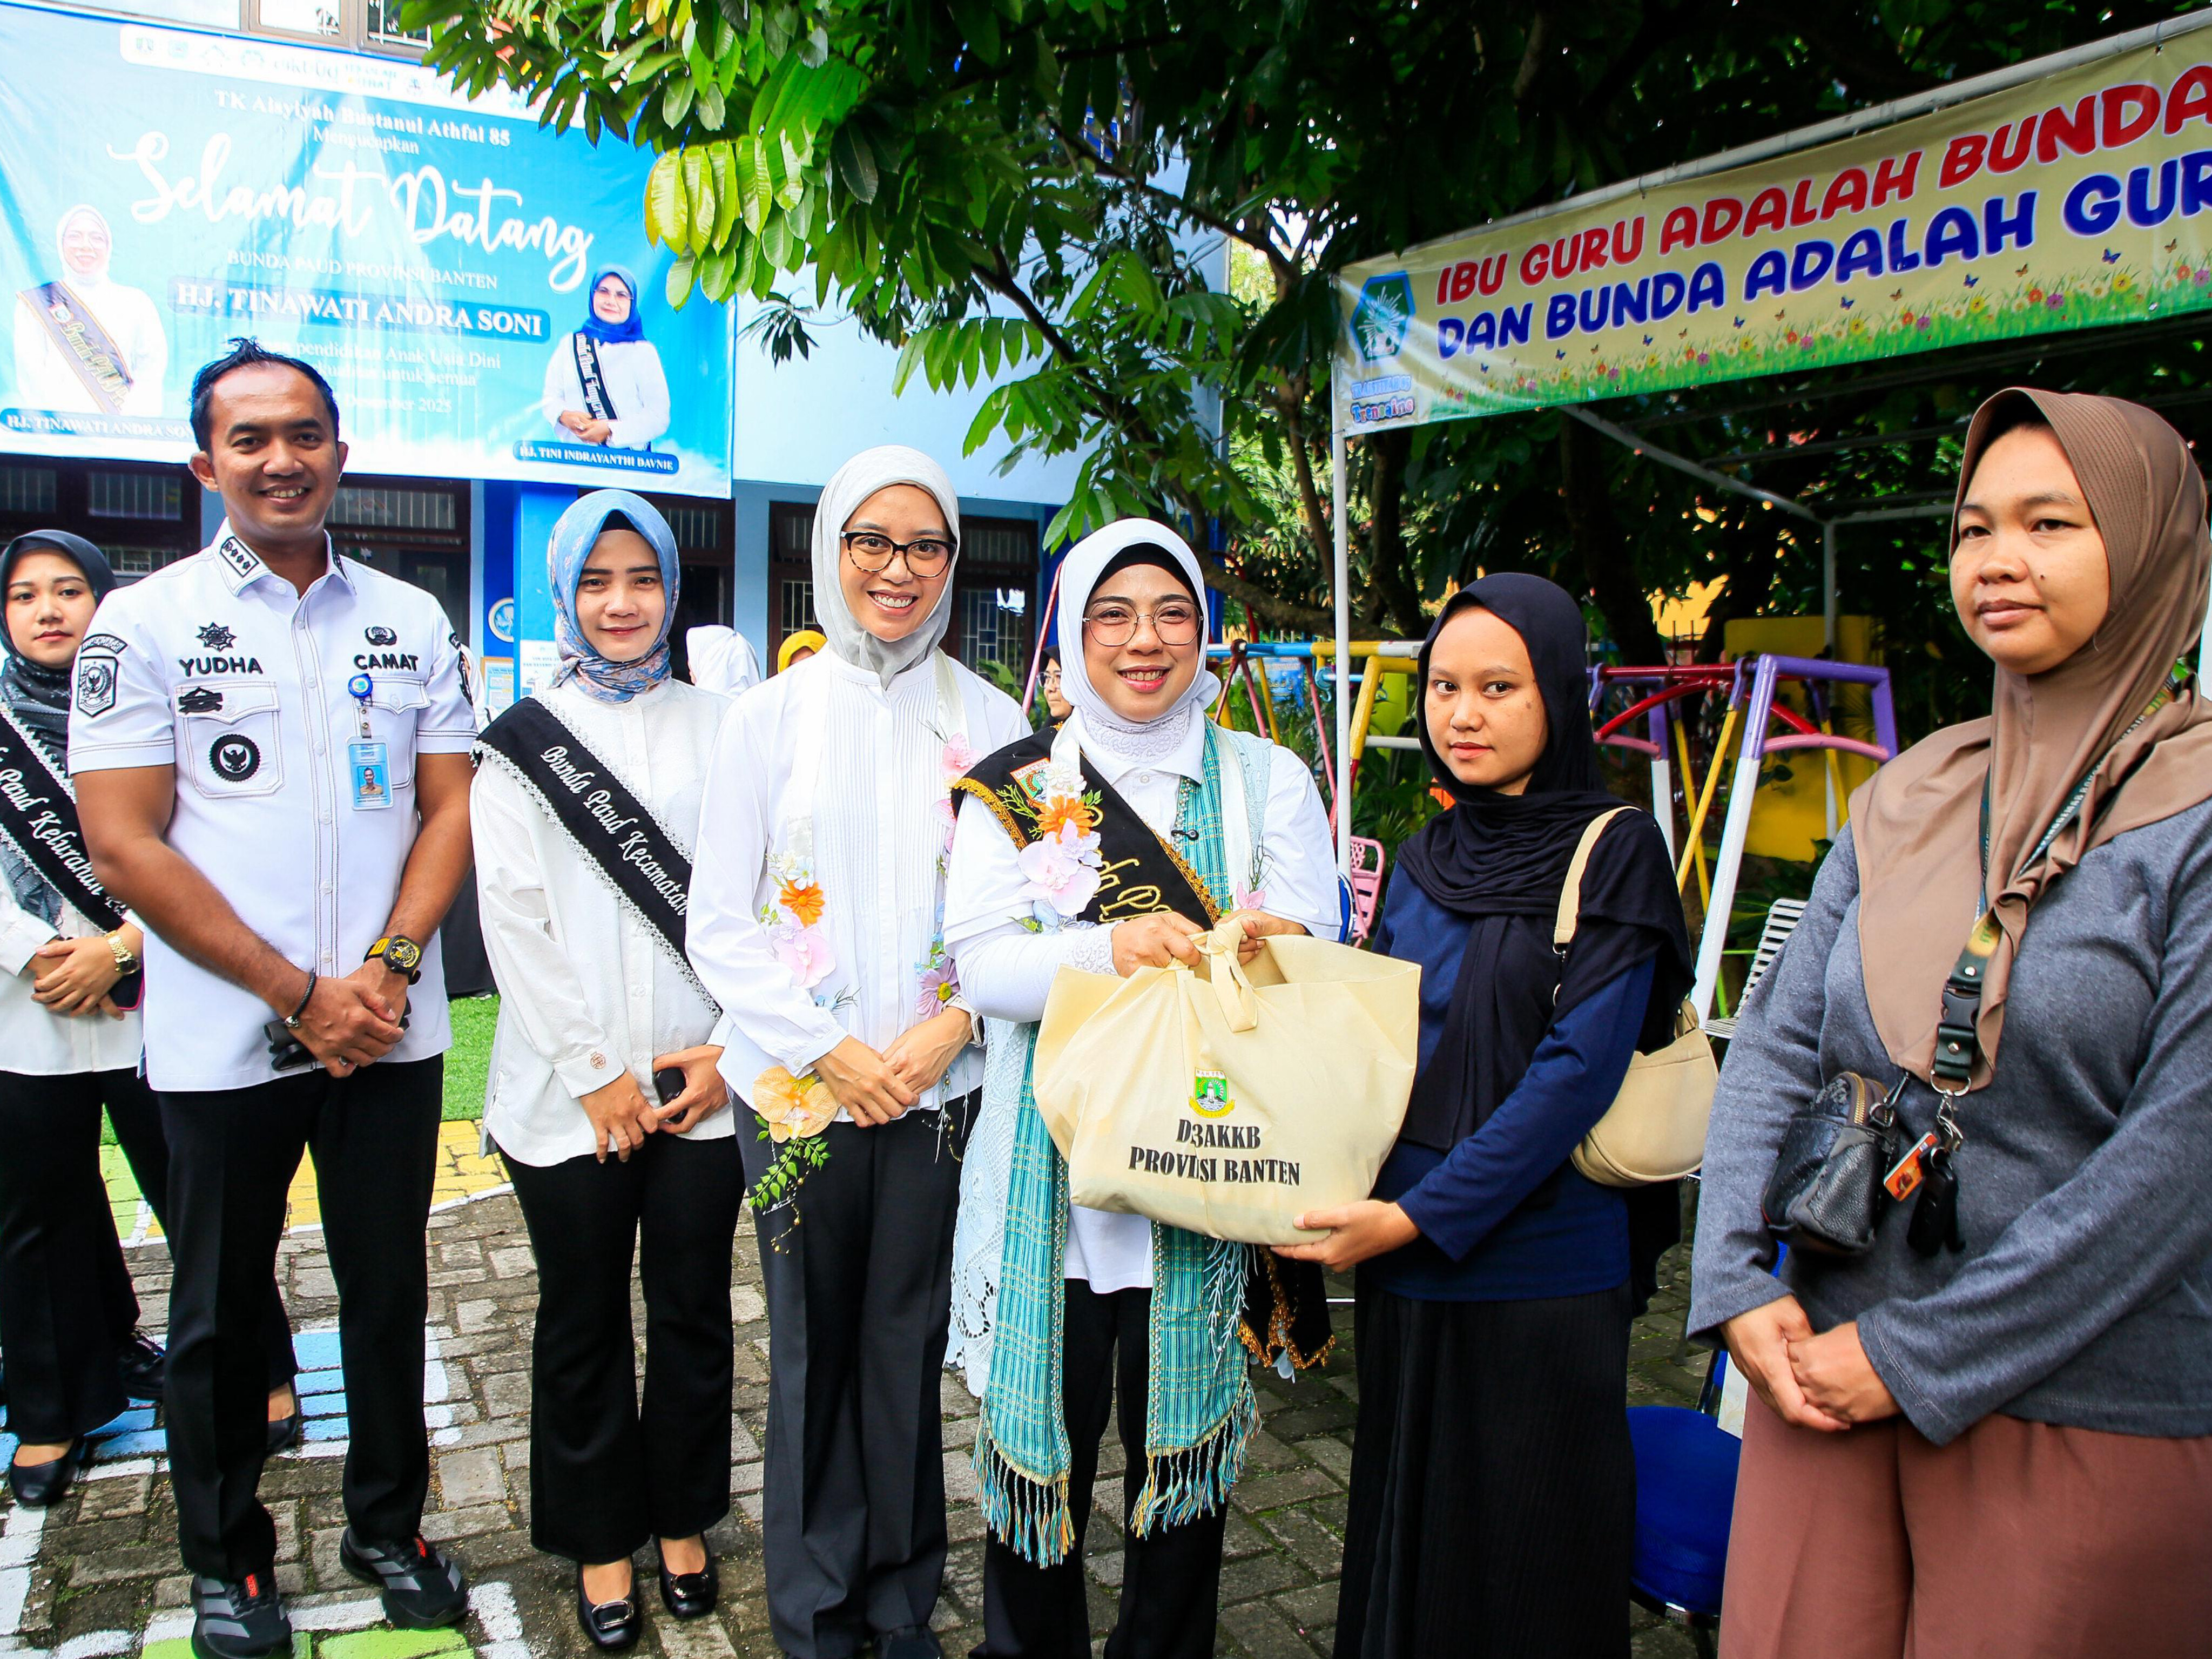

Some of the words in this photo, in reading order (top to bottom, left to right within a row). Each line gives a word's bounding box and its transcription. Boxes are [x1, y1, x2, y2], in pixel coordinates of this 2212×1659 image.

[214, 89, 246, 111] TK
[340, 107, 423, 135] Bustanul
[1437, 254, 1507, 304] IBU
[1520, 217, 1644, 286] GURU
[1660, 151, 1922, 255] ADALAH
[1940, 65, 2212, 189] BUNDA
[106, 131, 388, 238] Selamat
[389, 165, 594, 293] Datang
[227, 249, 292, 271] BUNDA
[431, 267, 498, 290] BANTEN
[1438, 302, 1532, 359] DAN
[1546, 262, 1724, 339] BUNDA
[1744, 191, 2037, 301] ADALAH
[177, 282, 222, 308] HJ.
[228, 287, 370, 322] TINAWATI
[374, 302, 474, 330] ANDRA
[477, 309, 543, 338] SONI
[386, 346, 426, 365] Anak
[469, 351, 502, 369] Dini
[6, 415, 31, 429] HJ.
[33, 417, 108, 433] TINAWATI
[112, 422, 163, 437] ANDRA
[166, 426, 193, 439] SON
[539, 447, 562, 459] TINI
[638, 457, 674, 471] DAVNIE
[179, 656, 262, 677] YUDHA
[354, 653, 419, 672] CAMAT
[0, 768, 49, 811] Paud
[540, 745, 594, 794] Bunda
[583, 789, 639, 835] Paud
[618, 831, 689, 916] Kecamatan
[1176, 1118, 1261, 1149] D3AKKB
[1224, 1159, 1300, 1186] BANTEN
